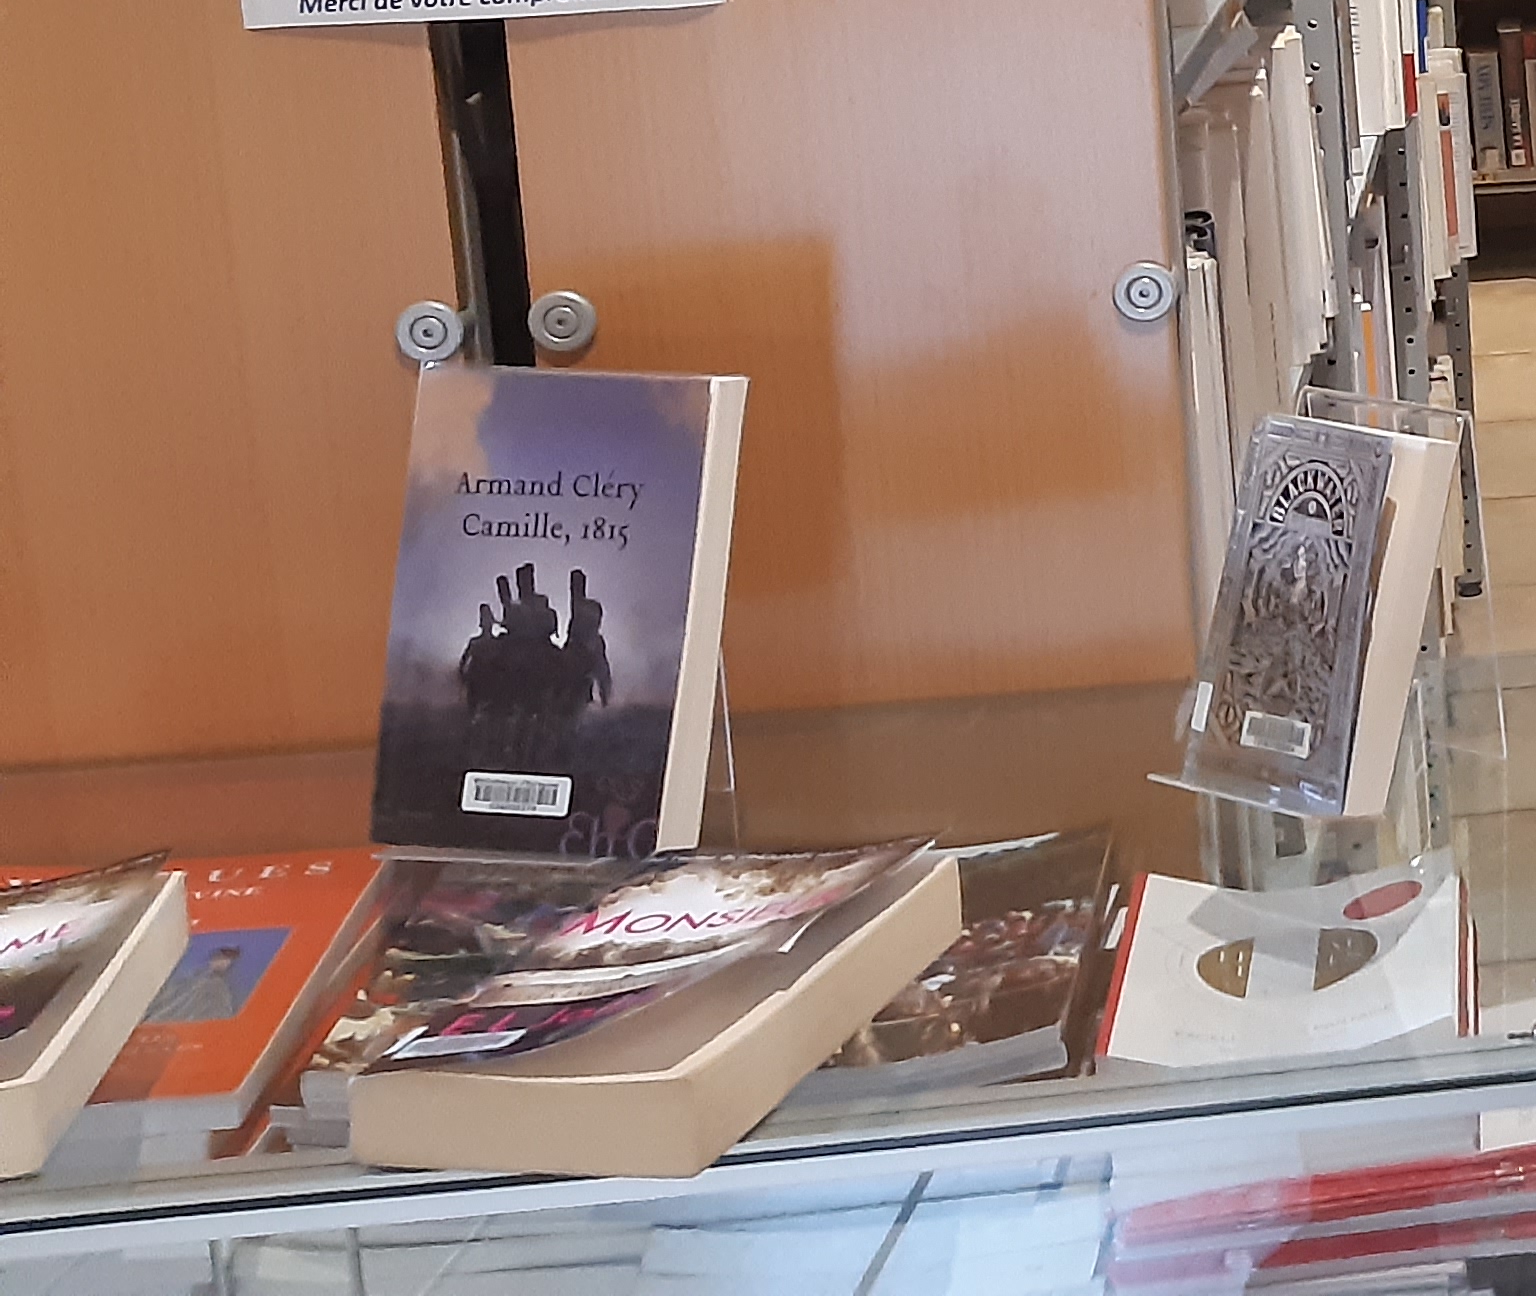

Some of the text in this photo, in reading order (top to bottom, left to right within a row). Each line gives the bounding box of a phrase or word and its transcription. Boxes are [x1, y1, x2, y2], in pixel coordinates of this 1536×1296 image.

[455, 469, 645, 509] Armand Cléry
[461, 512, 630, 551] Camille, 1815
